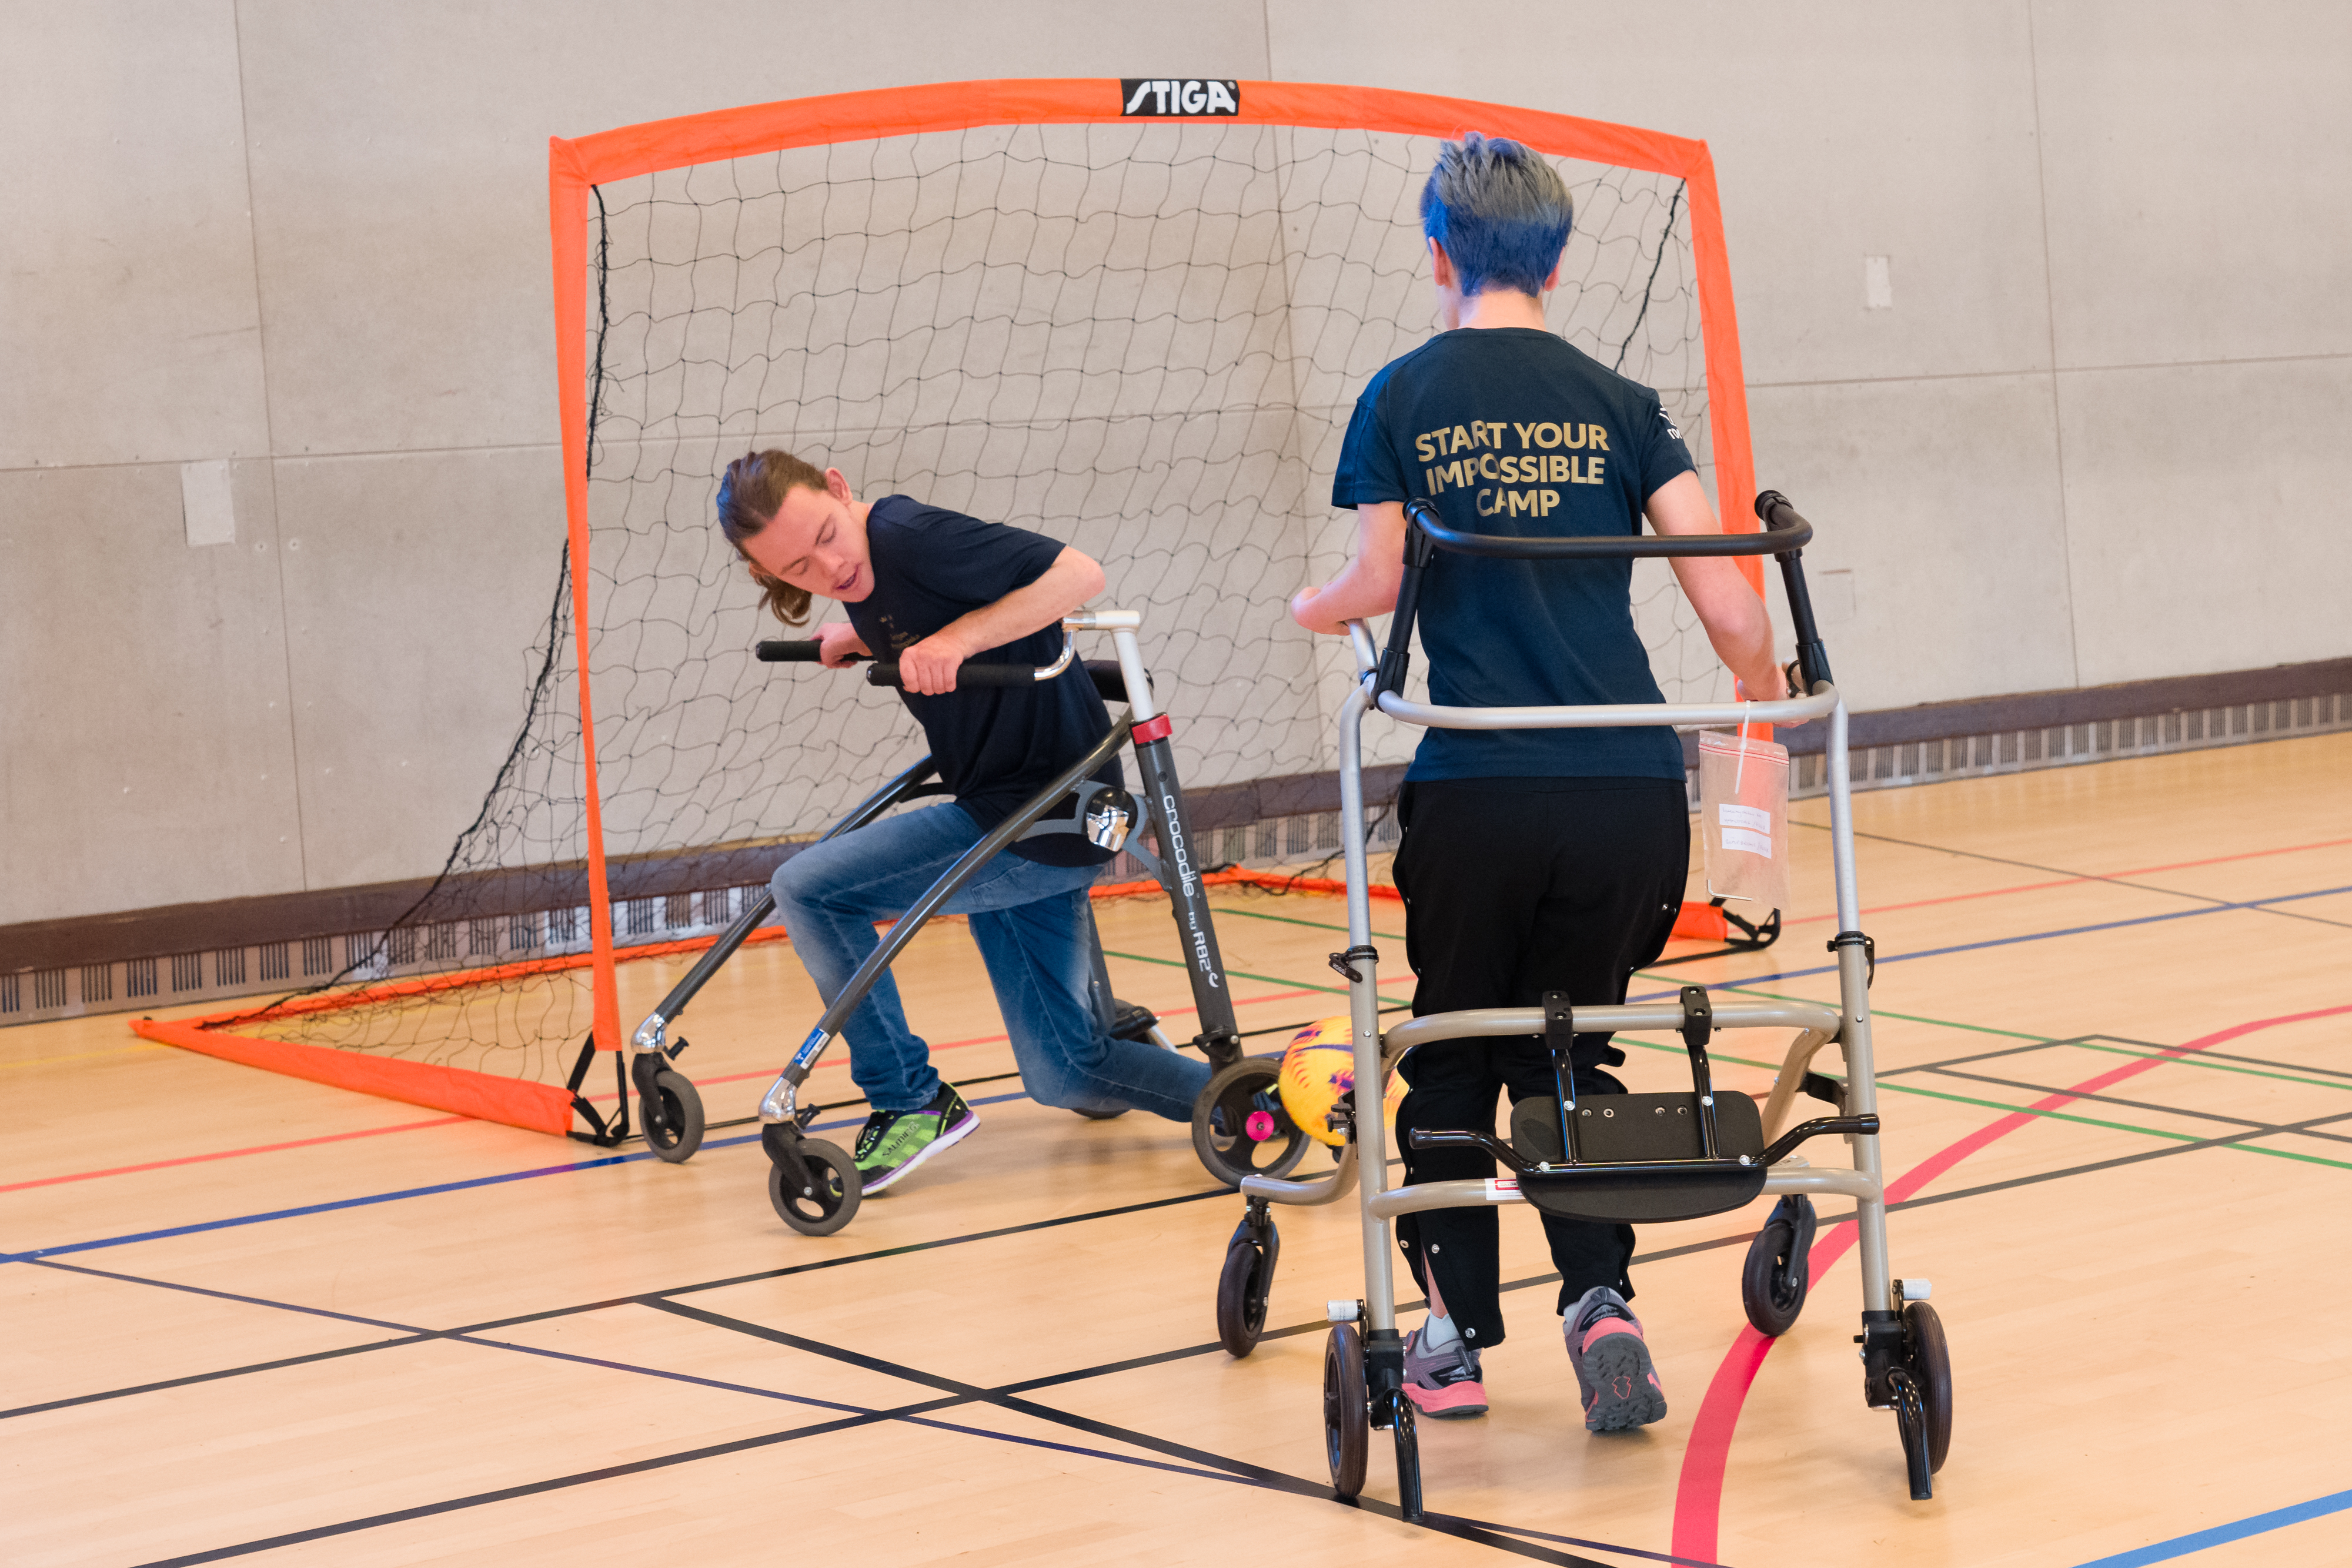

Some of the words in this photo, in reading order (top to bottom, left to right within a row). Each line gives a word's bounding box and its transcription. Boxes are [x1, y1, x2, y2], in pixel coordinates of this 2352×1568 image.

[1125, 81, 1236, 114] STIGA
[1415, 420, 1507, 462] START
[1514, 422, 1610, 452] YOUR
[1426, 453, 1605, 496] IMPOSSIBLE
[1476, 487, 1560, 517] CAMP
[1163, 795, 1197, 897] crocodile
[1188, 911, 1197, 930] by
